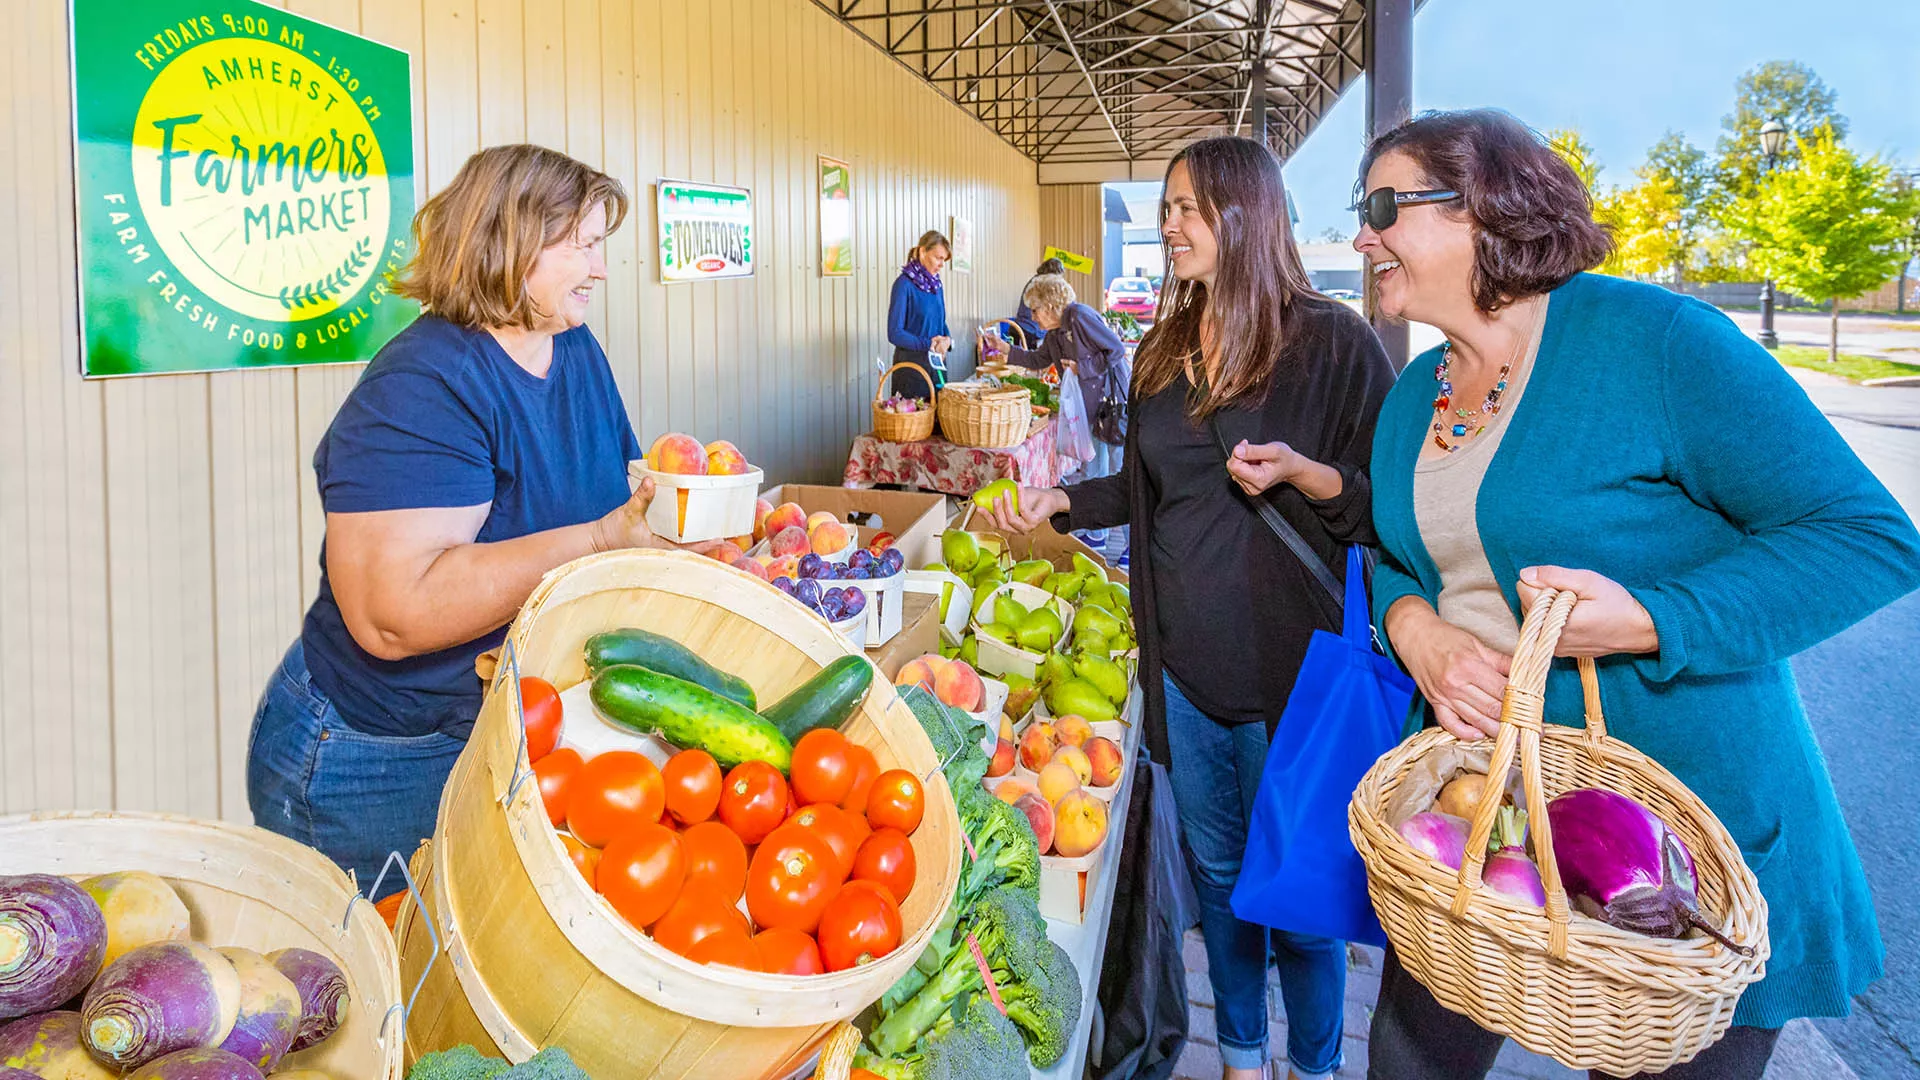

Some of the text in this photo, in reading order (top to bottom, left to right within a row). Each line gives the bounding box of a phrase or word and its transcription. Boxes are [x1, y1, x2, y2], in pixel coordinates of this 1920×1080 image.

[135, 15, 215, 71] FRIDAYS
[222, 13, 268, 37] 9:00
[279, 25, 304, 50] AM
[327, 56, 360, 92] 1:30
[360, 95, 382, 122] PM
[202, 57, 338, 112] AMHERST
[152, 114, 372, 207] Farmers
[244, 186, 371, 245] MARKET
[673, 220, 743, 270] TOMATOES
[103, 192, 406, 350] FARM FRESH FOOD & LOCAL CRAFTS
